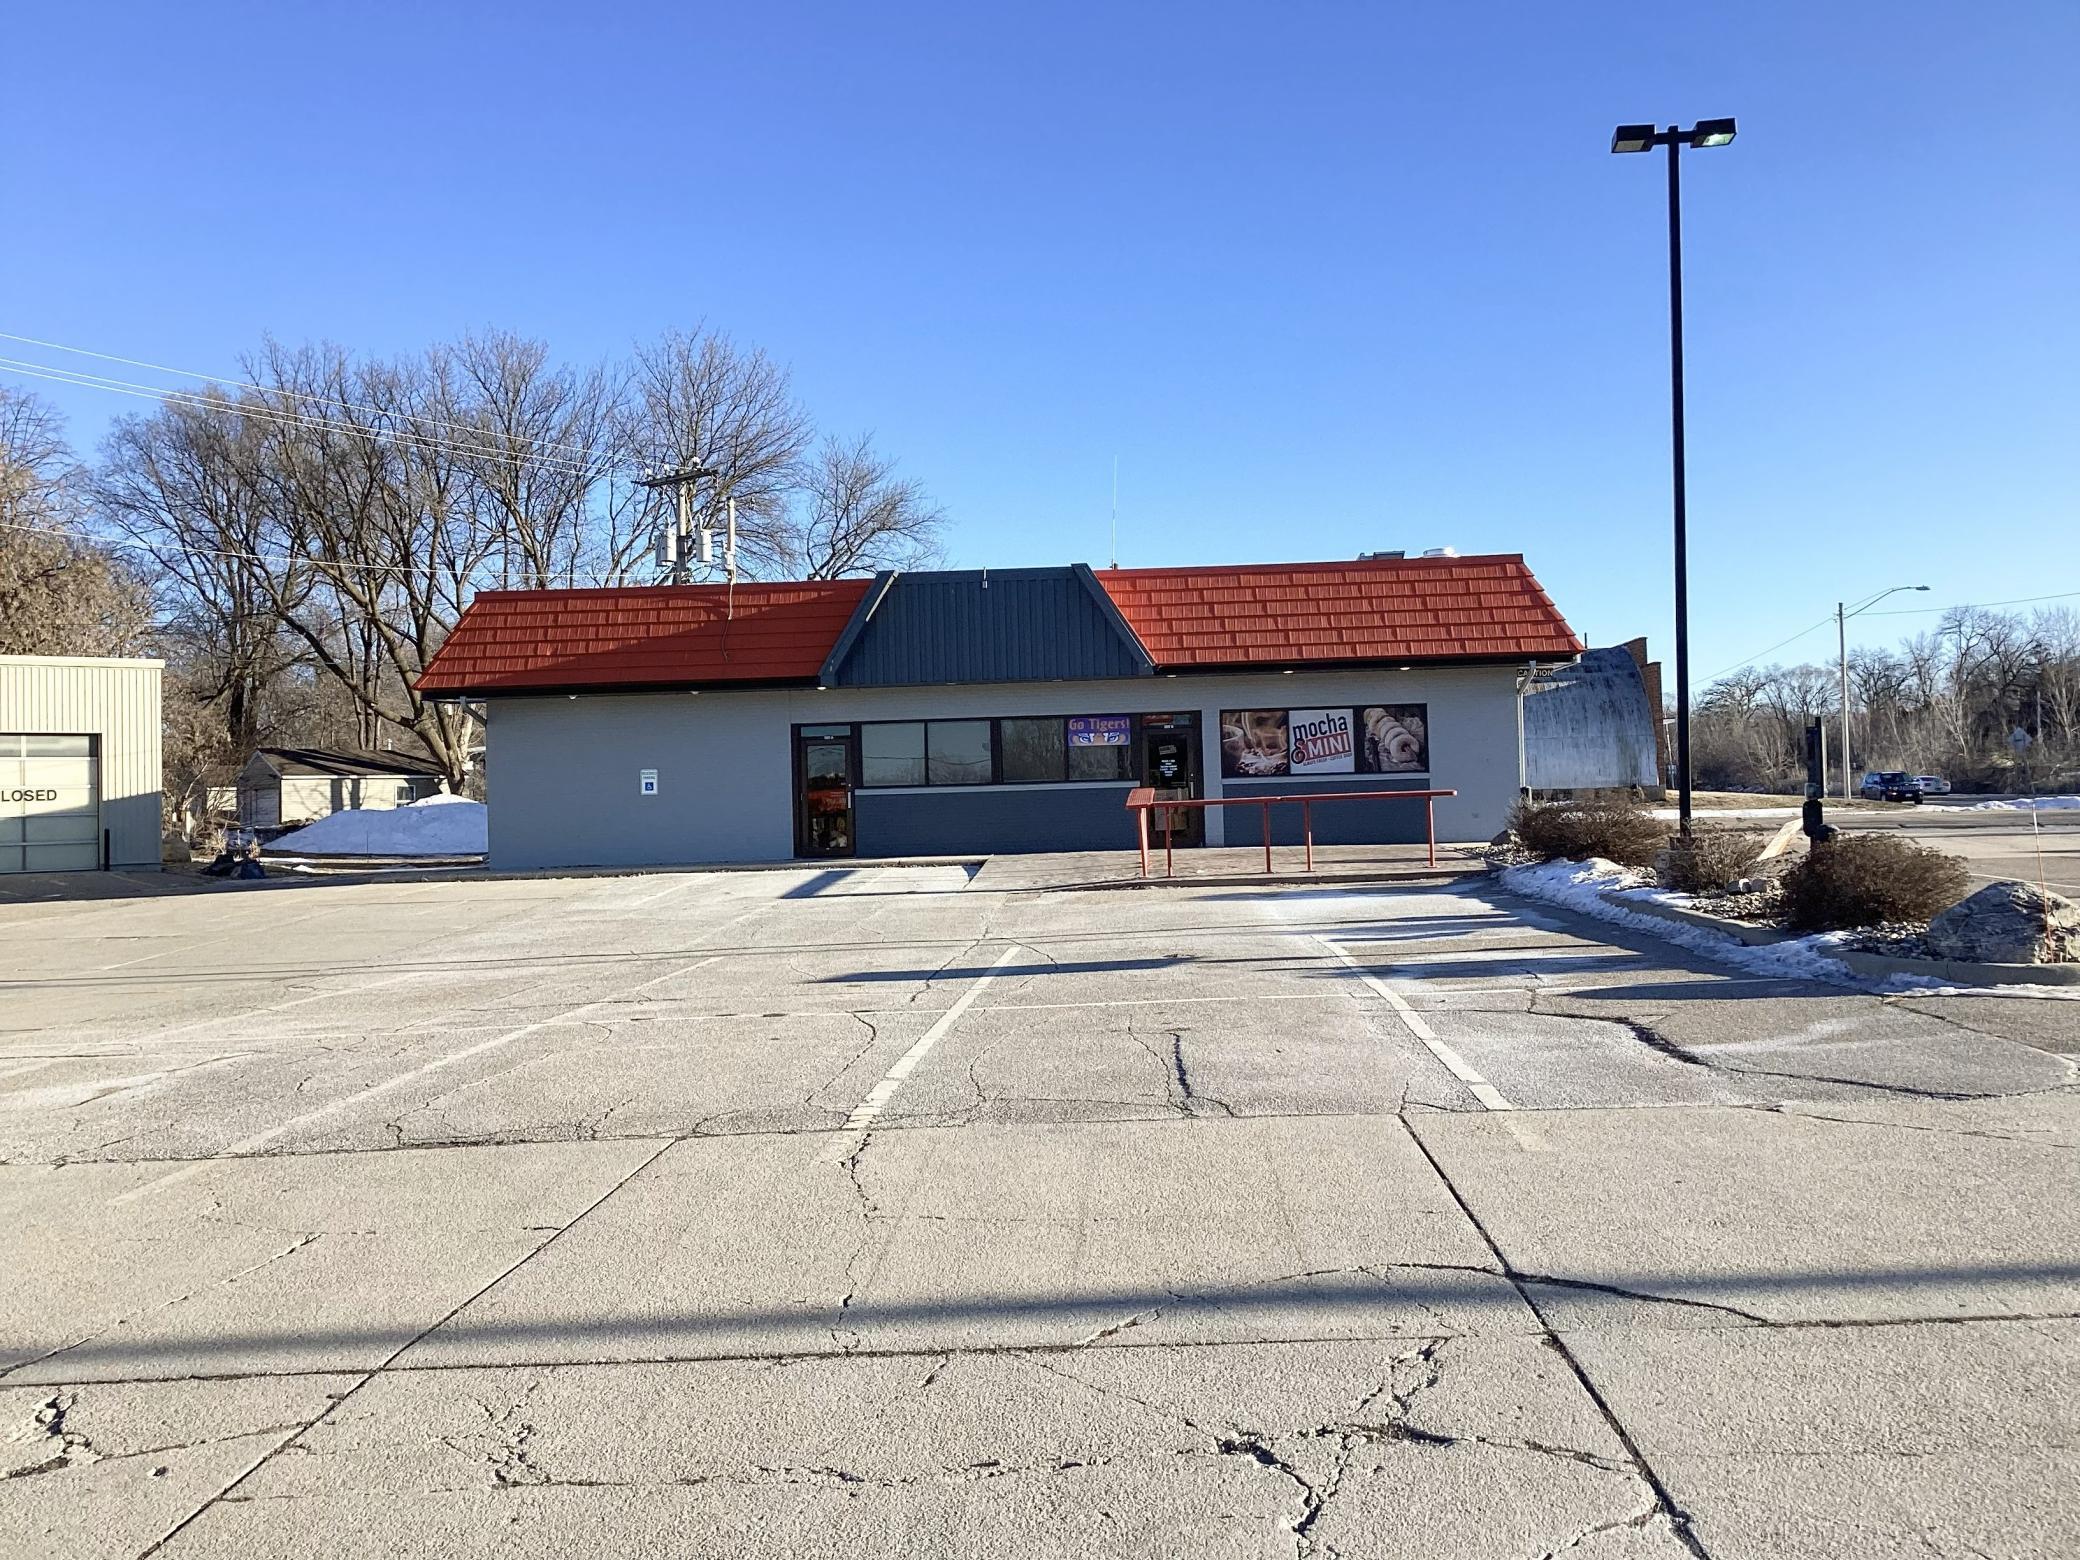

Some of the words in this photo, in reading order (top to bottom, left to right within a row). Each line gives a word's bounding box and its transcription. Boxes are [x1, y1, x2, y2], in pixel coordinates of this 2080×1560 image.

[1517, 669, 1553, 677] CATION
[1069, 719, 1085, 731] Go
[1088, 718, 1130, 732] Tigers!
[1292, 712, 1348, 739] mocha
[1, 788, 58, 802] LOSED
